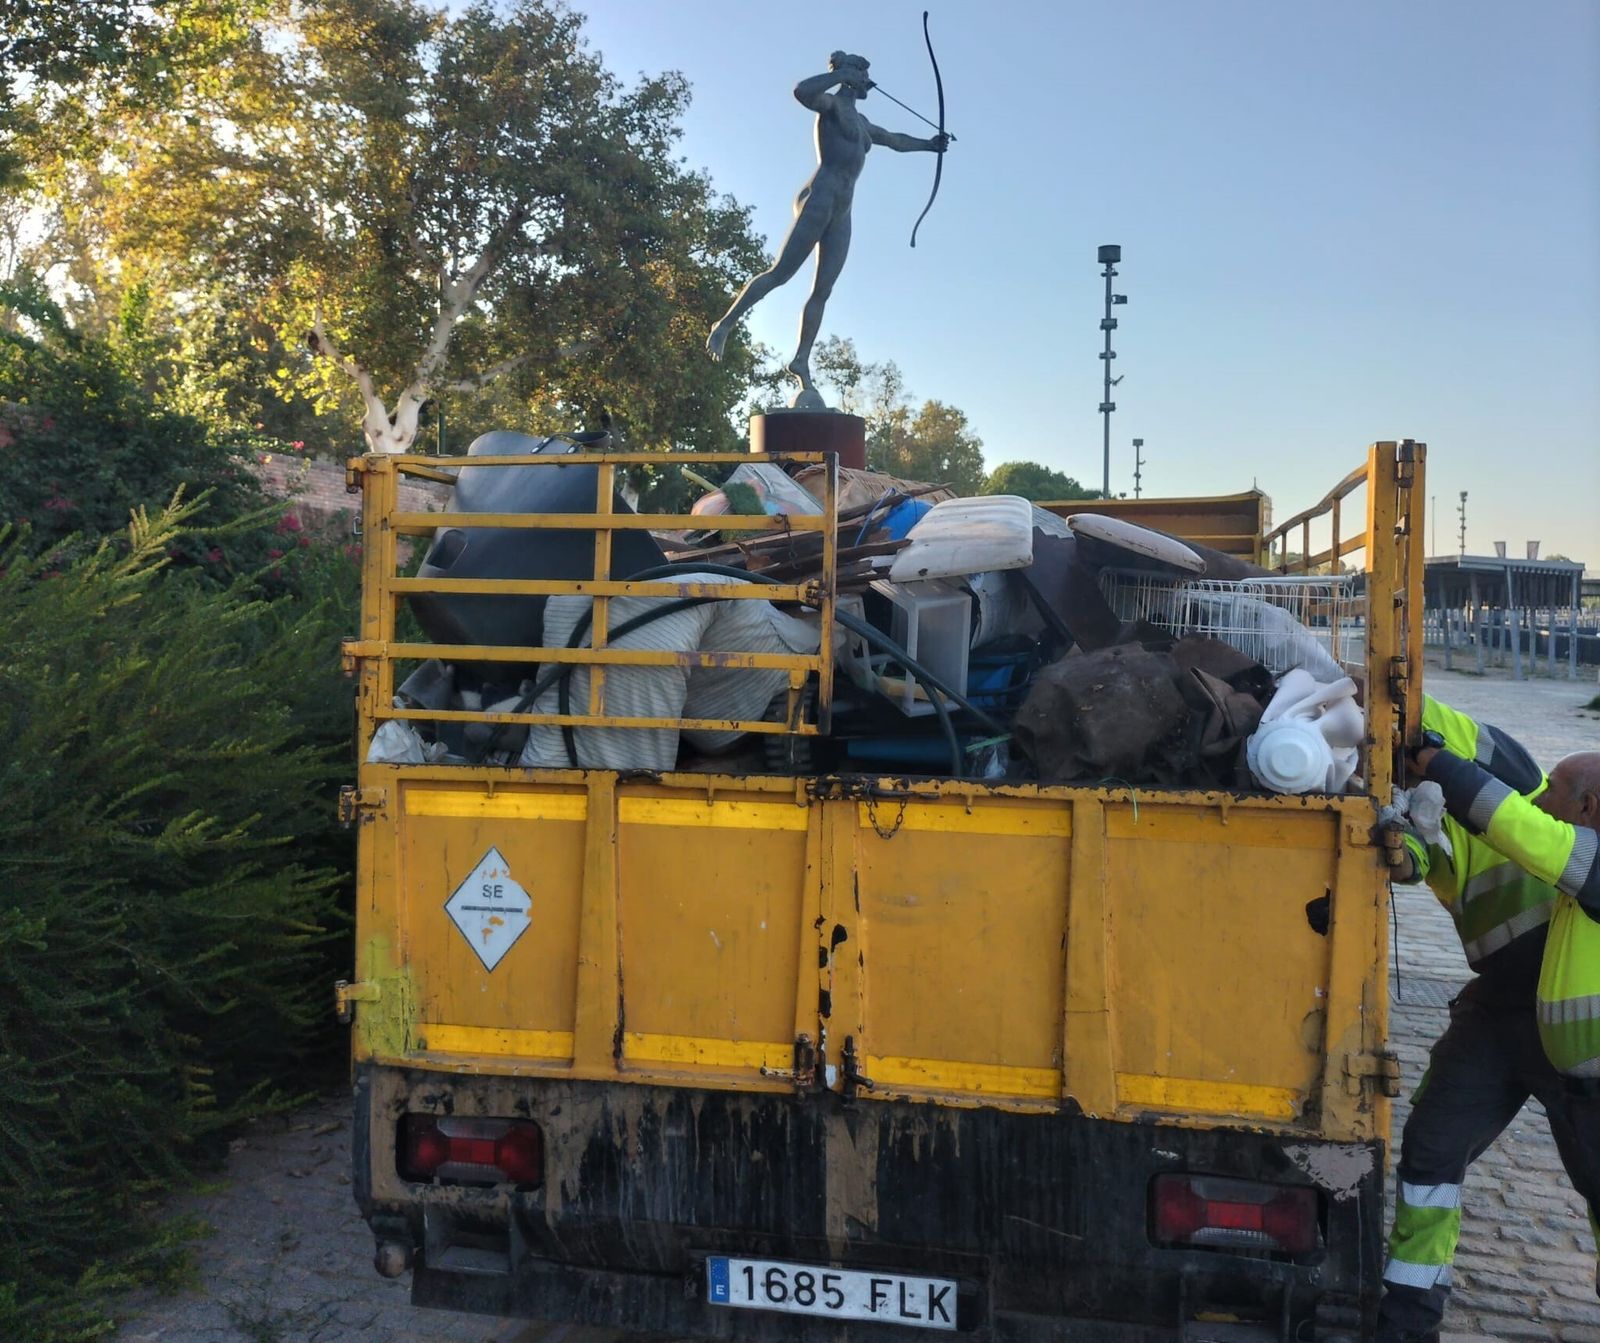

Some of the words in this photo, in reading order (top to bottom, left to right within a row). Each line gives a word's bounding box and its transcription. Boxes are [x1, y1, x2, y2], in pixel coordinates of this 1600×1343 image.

[482, 884, 503, 898] SE
[716, 1284, 725, 1296] E
[742, 1266, 845, 1309] 1685
[870, 1278, 951, 1323] FLK
